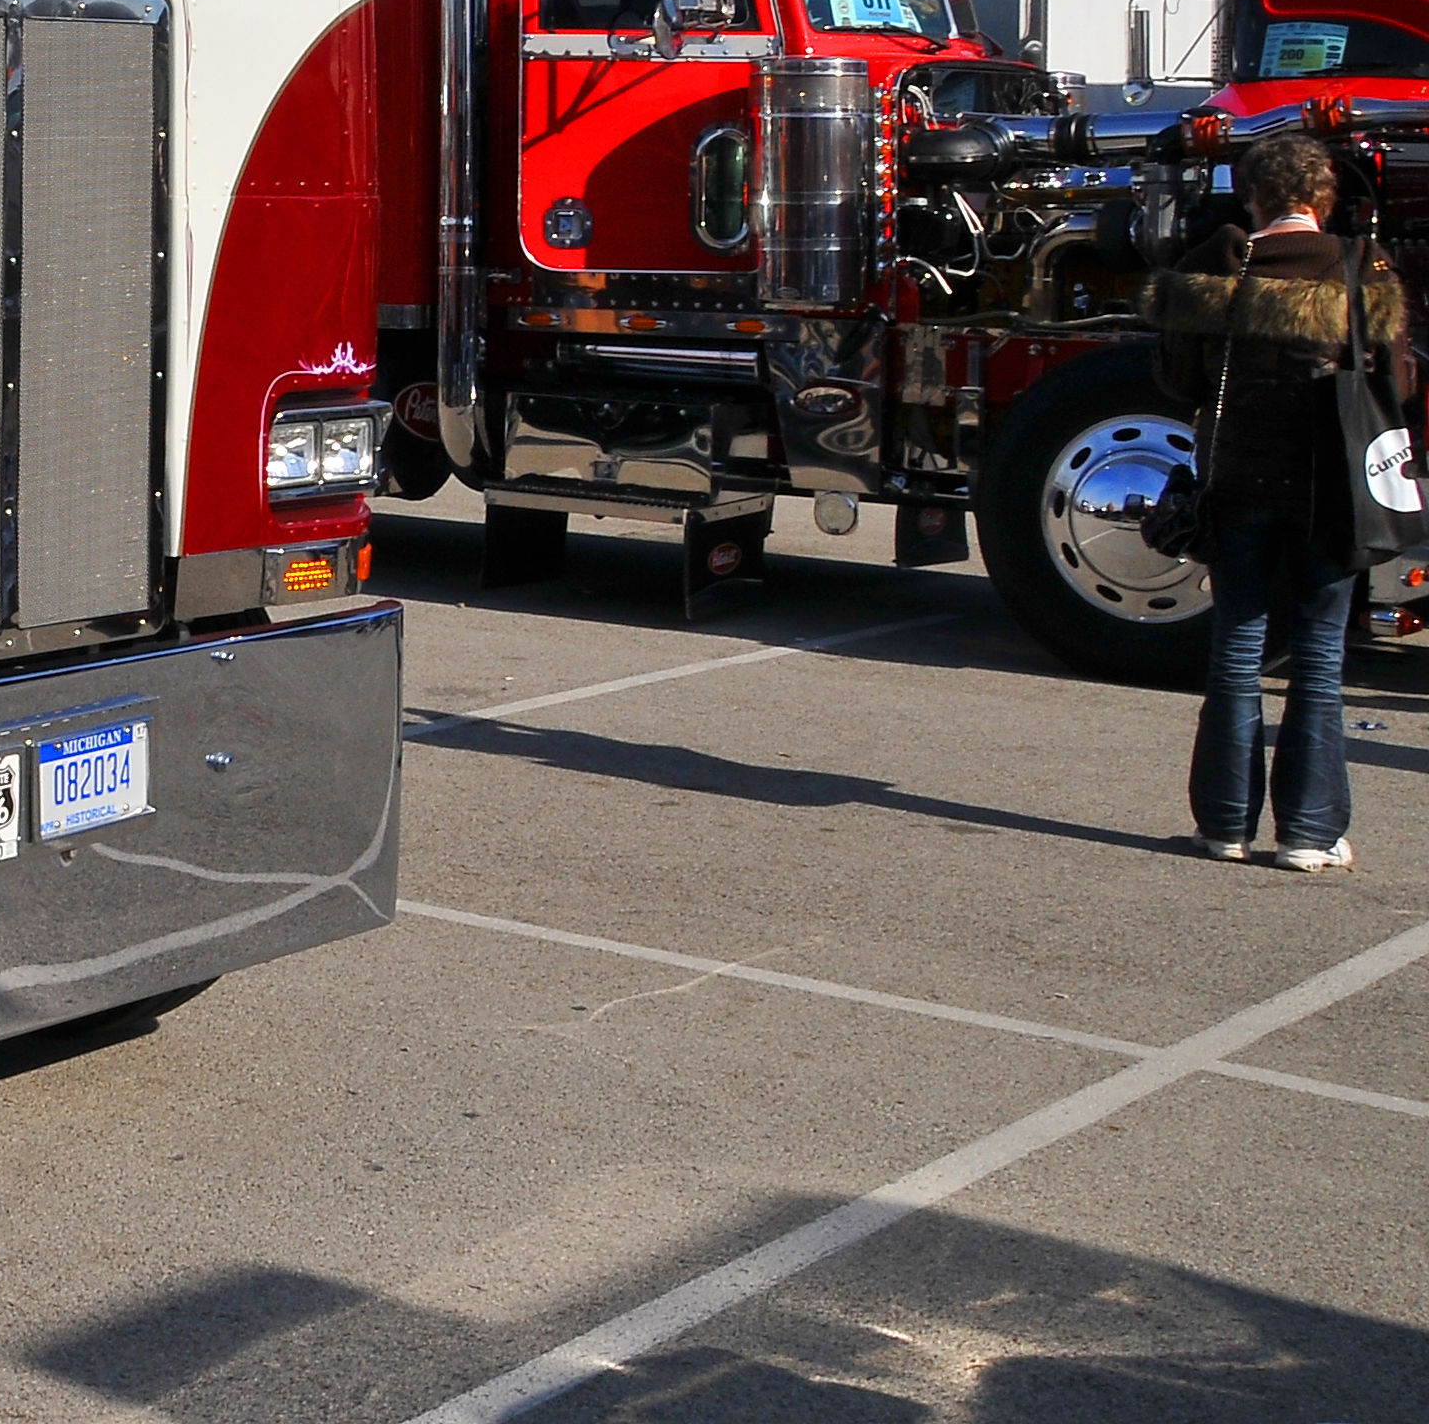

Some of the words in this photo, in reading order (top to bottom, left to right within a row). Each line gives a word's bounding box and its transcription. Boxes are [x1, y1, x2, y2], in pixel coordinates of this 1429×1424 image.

[63, 730, 122, 755] MICHIGAN
[54, 749, 130, 805] 082034
[66, 804, 117, 825] HISTORICAL
